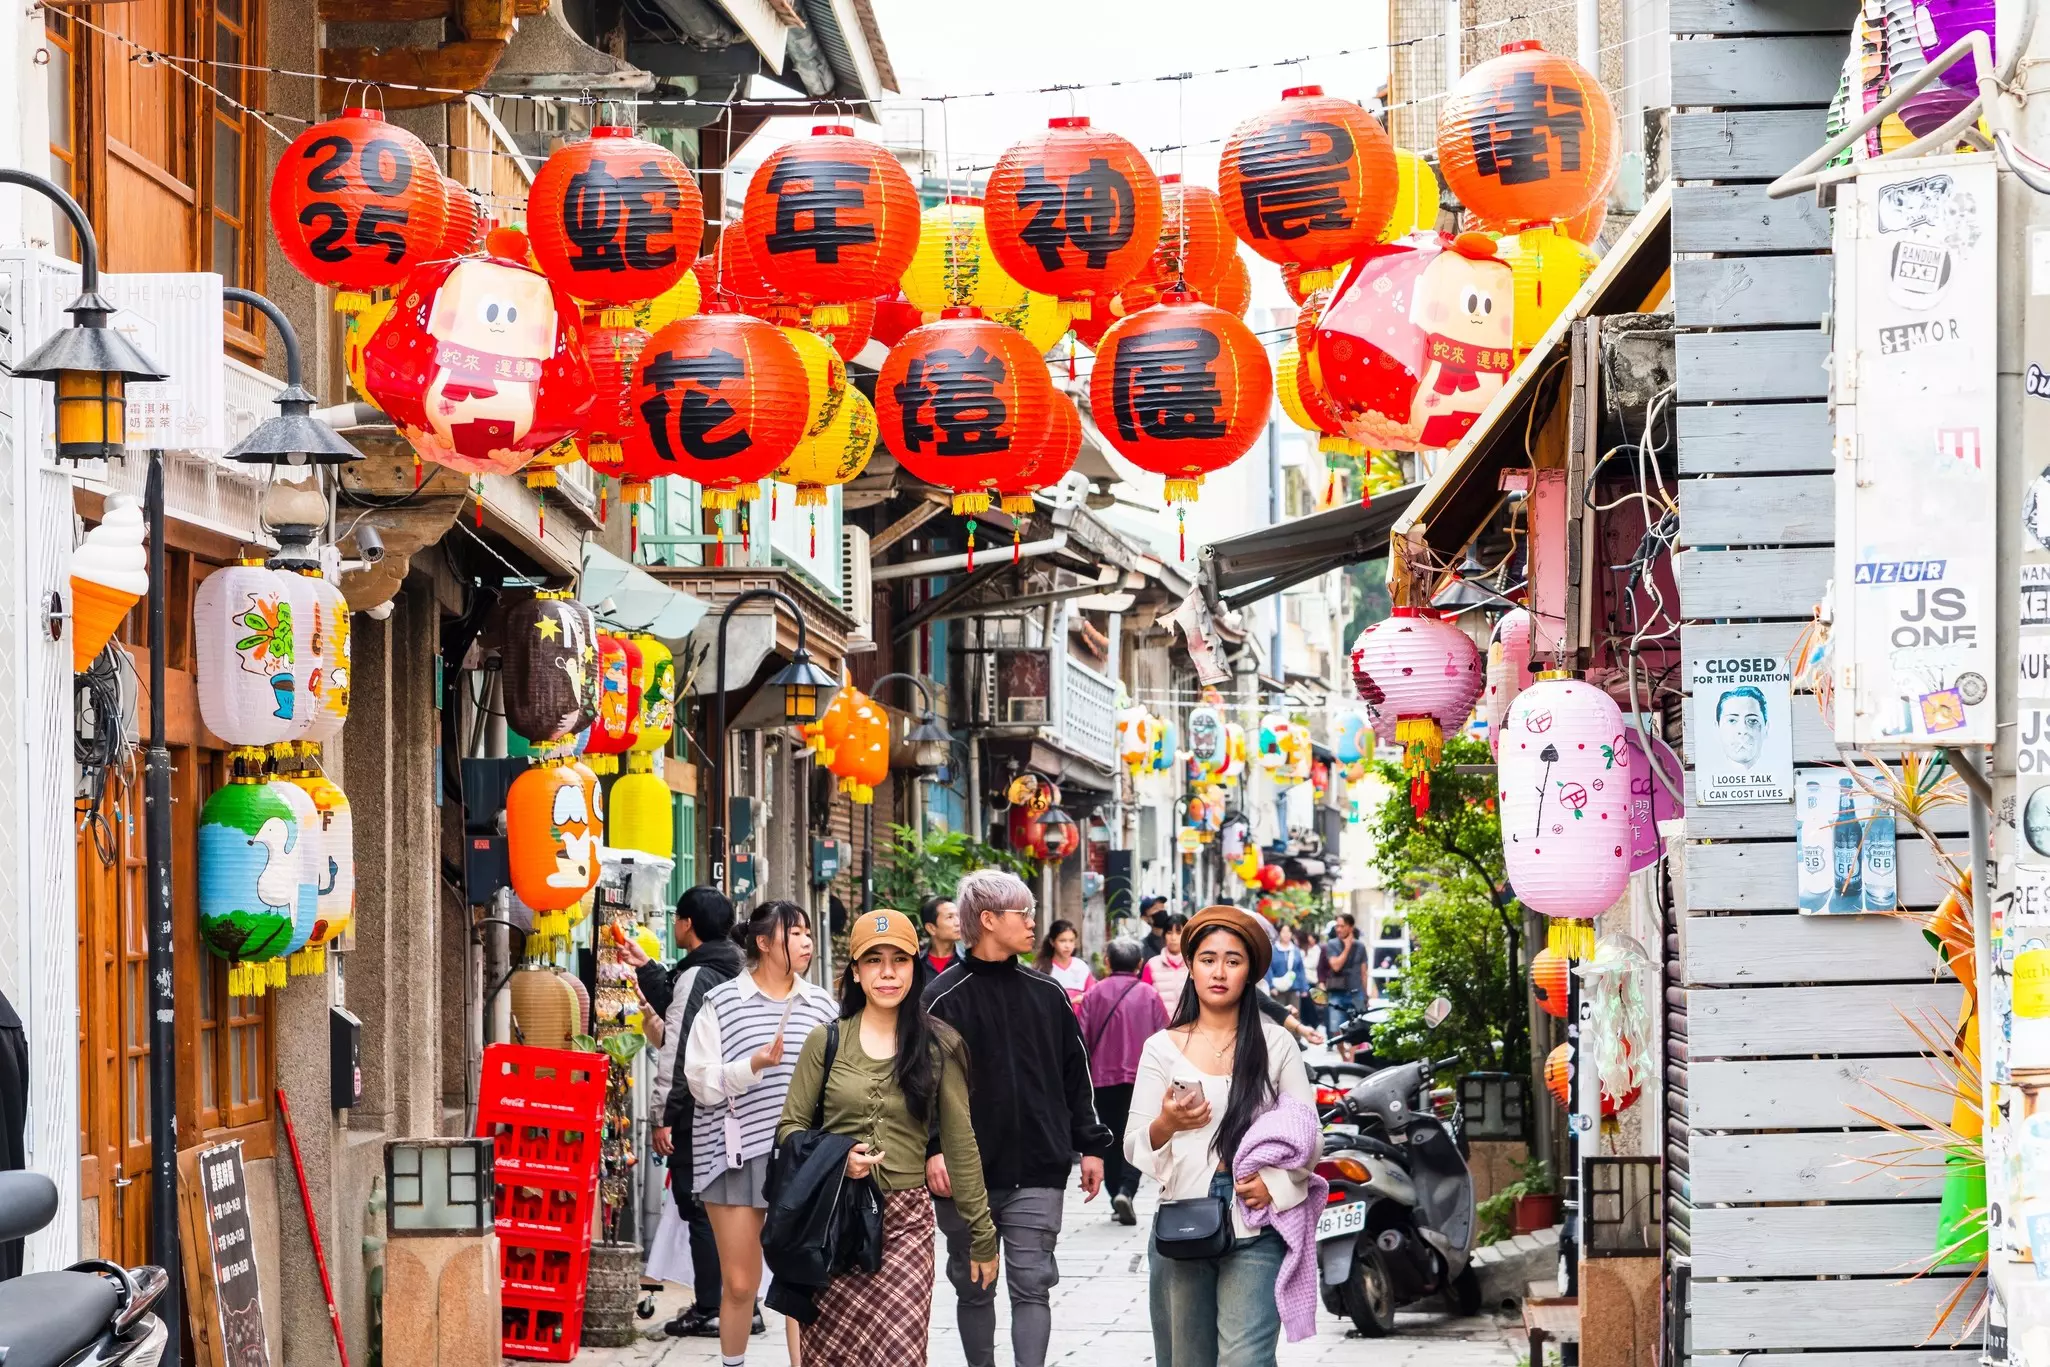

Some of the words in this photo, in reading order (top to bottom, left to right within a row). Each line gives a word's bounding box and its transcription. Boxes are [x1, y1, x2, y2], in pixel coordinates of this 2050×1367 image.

[301, 135, 413, 198] 20
[563, 159, 681, 272] 蛇
[765, 157, 876, 264] 年
[1016, 158, 1135, 272] 神
[299, 202, 408, 264] 25
[1902, 245, 1941, 265] RANDOM
[128, 285, 152, 301] HE
[161, 284, 203, 301] HAO
[442, 347, 481, 371] 蛇來
[495, 359, 536, 379] 運轉
[1433, 340, 1466, 364] 蛇來
[1476, 350, 1510, 370] 運轉
[129, 403, 171, 415] 霜淇淋
[641, 346, 752, 462] 花
[893, 345, 1011, 457] 燈
[1855, 560, 1946, 584] AZUR
[1900, 587, 1967, 622] JS
[1891, 626, 1977, 649] ONE
[1706, 658, 1776, 674] CLOSED
[1693, 675, 1713, 684] FOR
[1716, 675, 1735, 684] THE
[1739, 673, 1790, 683] DURATION
[1717, 775, 1746, 784] LOOSE
[1750, 774, 1772, 784] TALK
[1710, 790, 1728, 799] CAN
[1730, 789, 1753, 799] COST
[1757, 788, 1783, 798] LIVES
[1873, 858, 1891, 868] 66
[874, 916, 890, 933] B
